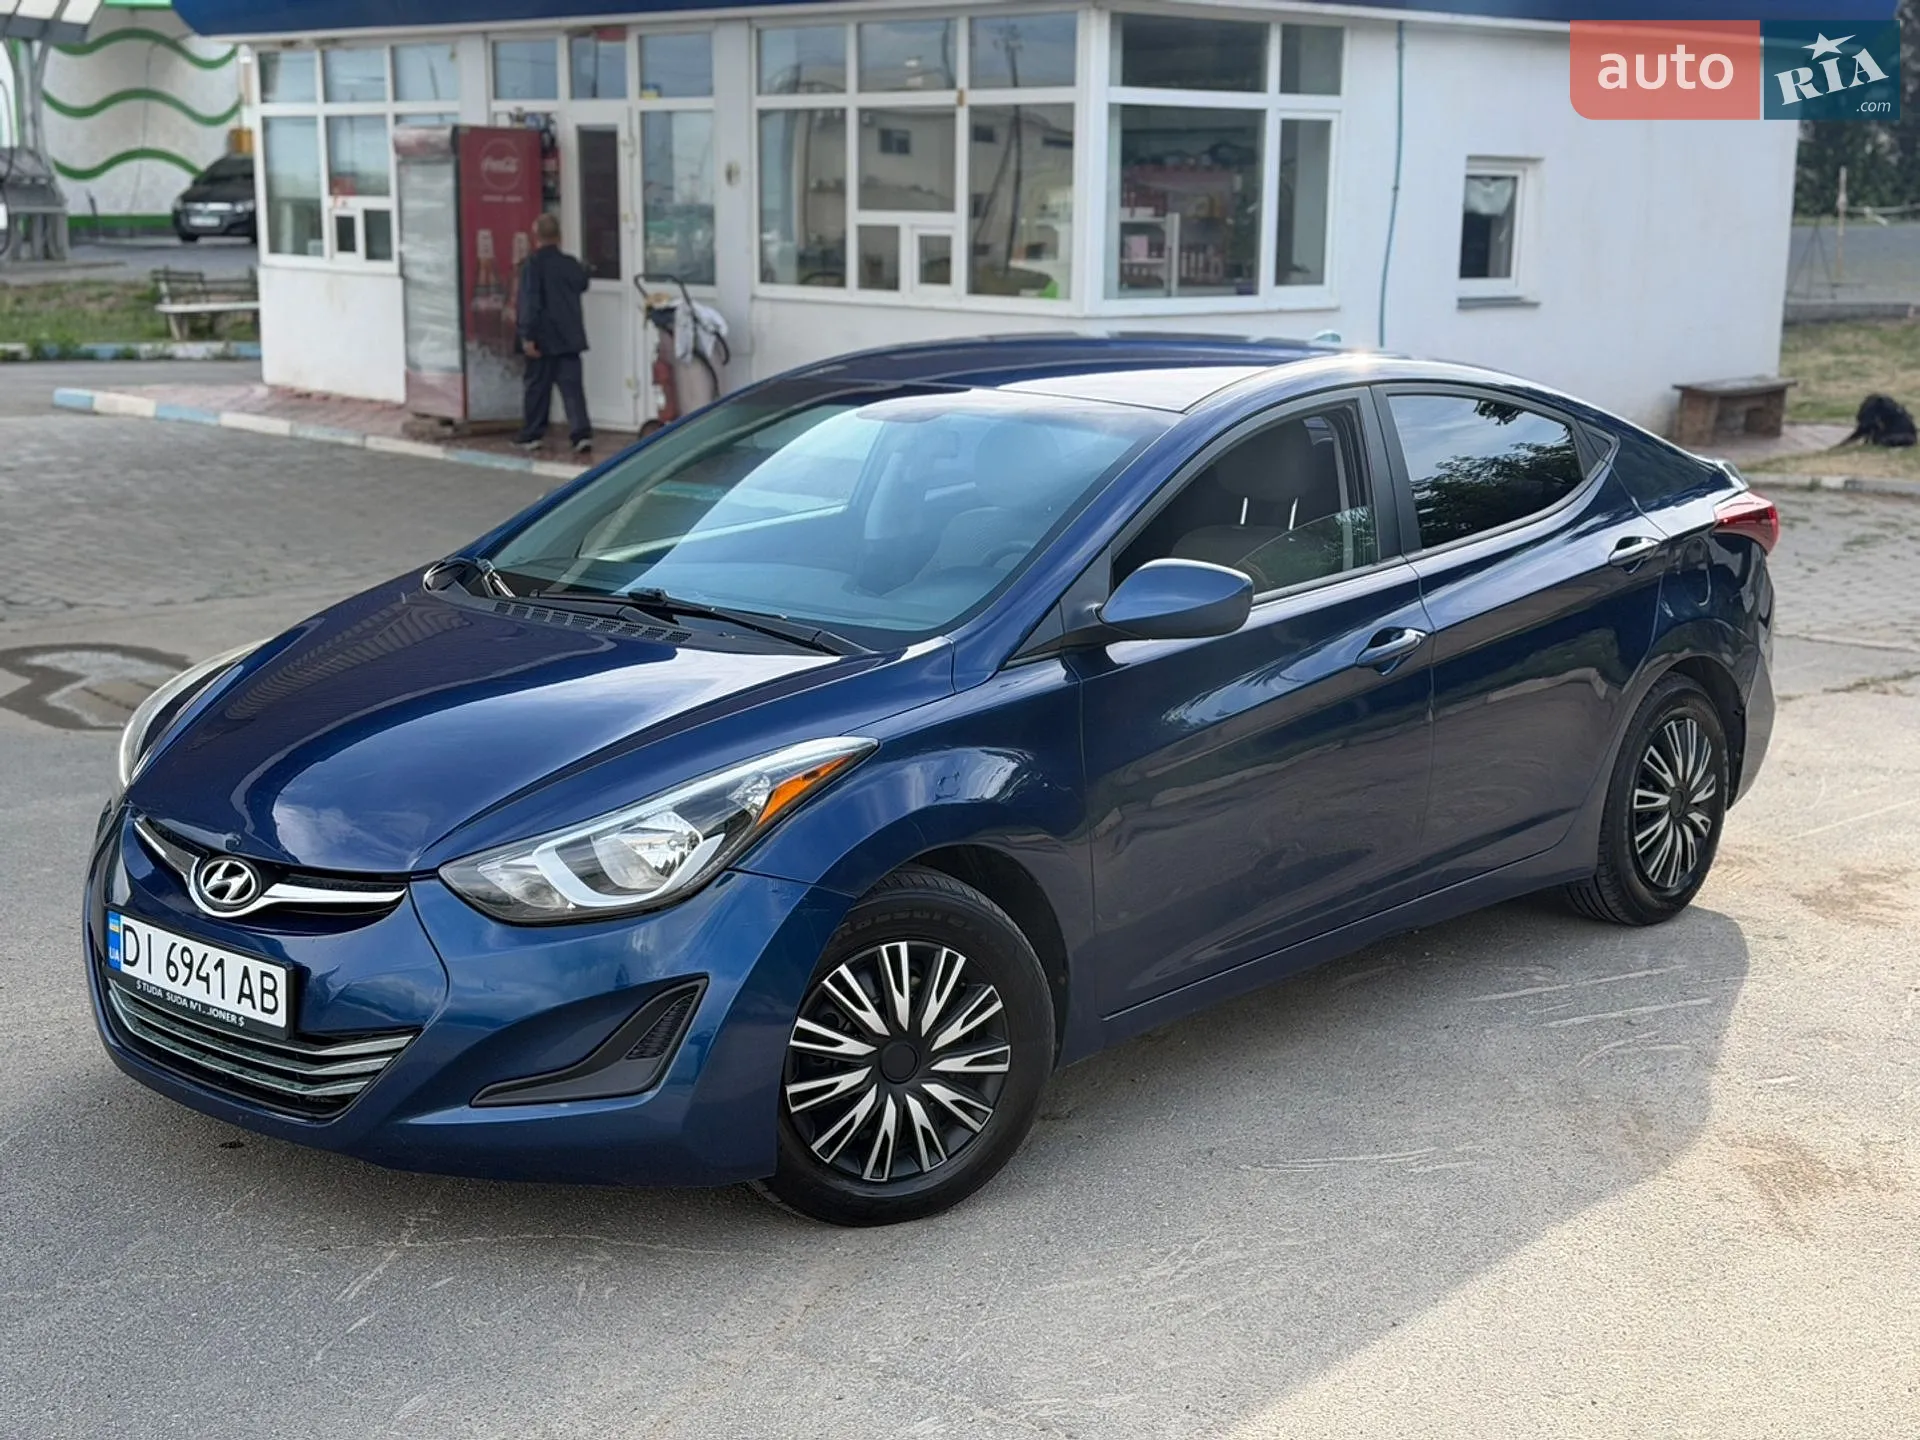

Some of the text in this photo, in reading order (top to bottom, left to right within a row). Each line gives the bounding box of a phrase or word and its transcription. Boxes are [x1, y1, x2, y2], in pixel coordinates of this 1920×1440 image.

[122, 923, 279, 1016] DI 6941 AB
[166, 991, 188, 1008] SUDA
